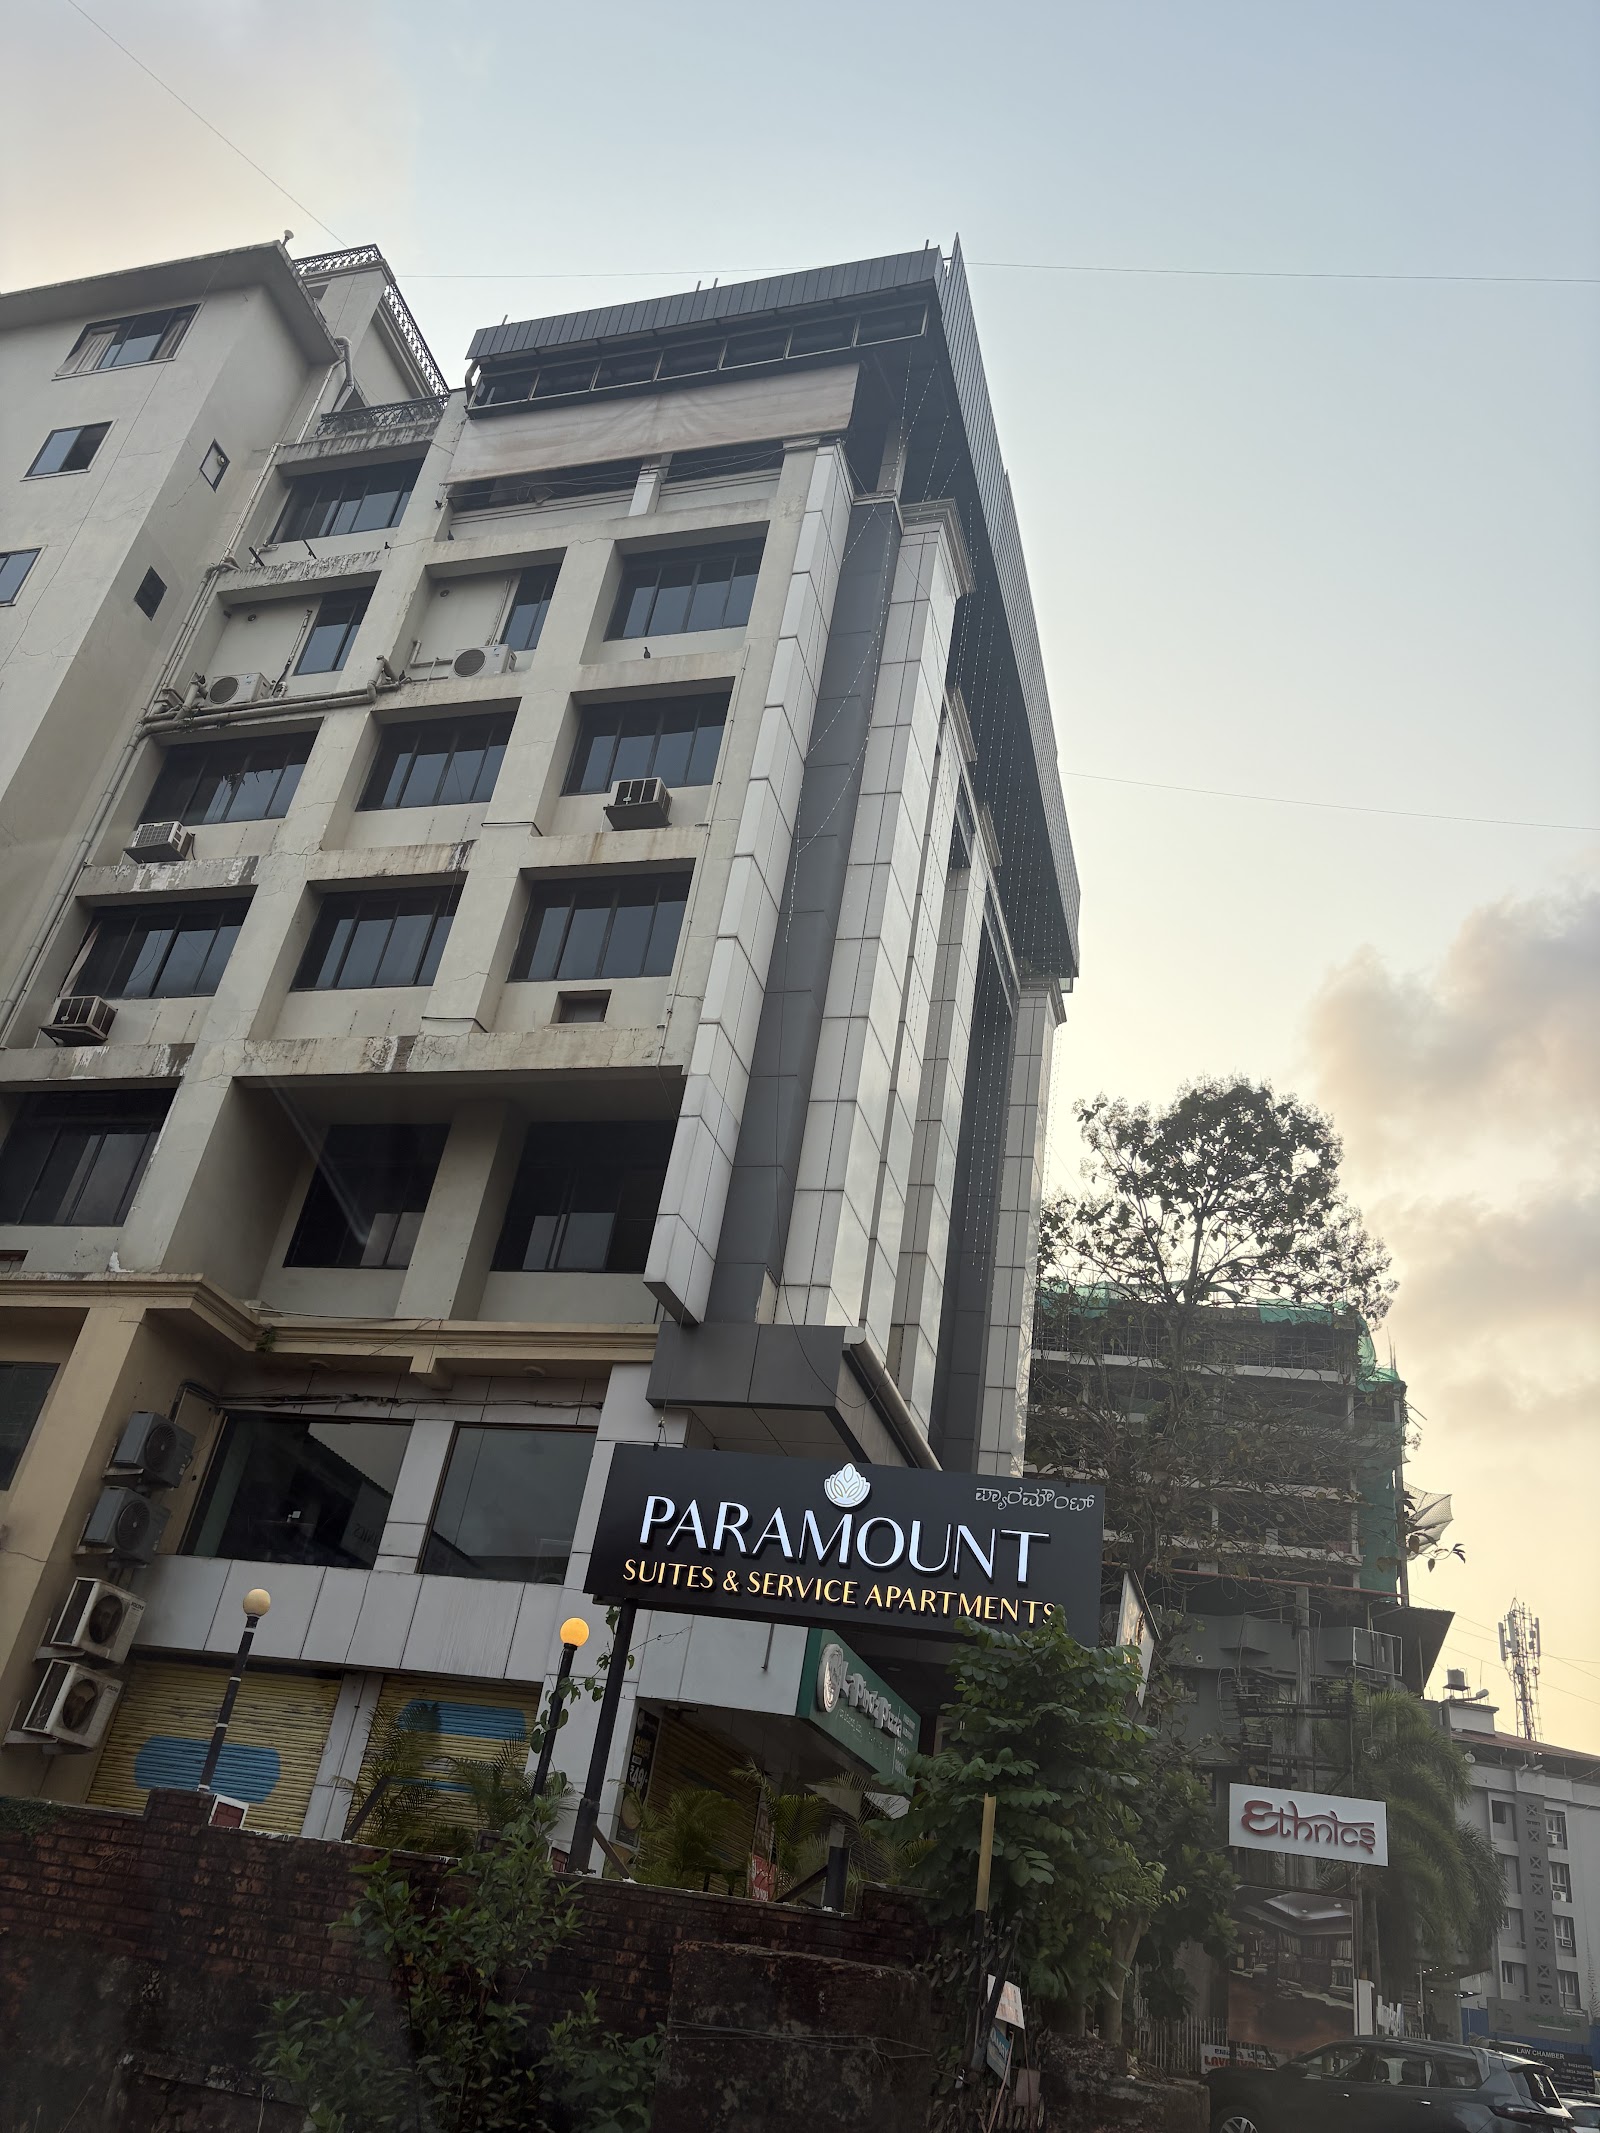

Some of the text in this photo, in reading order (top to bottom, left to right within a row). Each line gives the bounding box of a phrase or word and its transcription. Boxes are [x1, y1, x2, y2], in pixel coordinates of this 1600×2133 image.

[638, 1494, 1051, 1585] PARAMOUNT
[622, 1558, 1056, 1627] SUITES & SERVICE APARTMENTS
[1241, 1800, 1376, 1854] Ethnics
[1516, 2047, 1565, 2060] LAW CHAMBER
